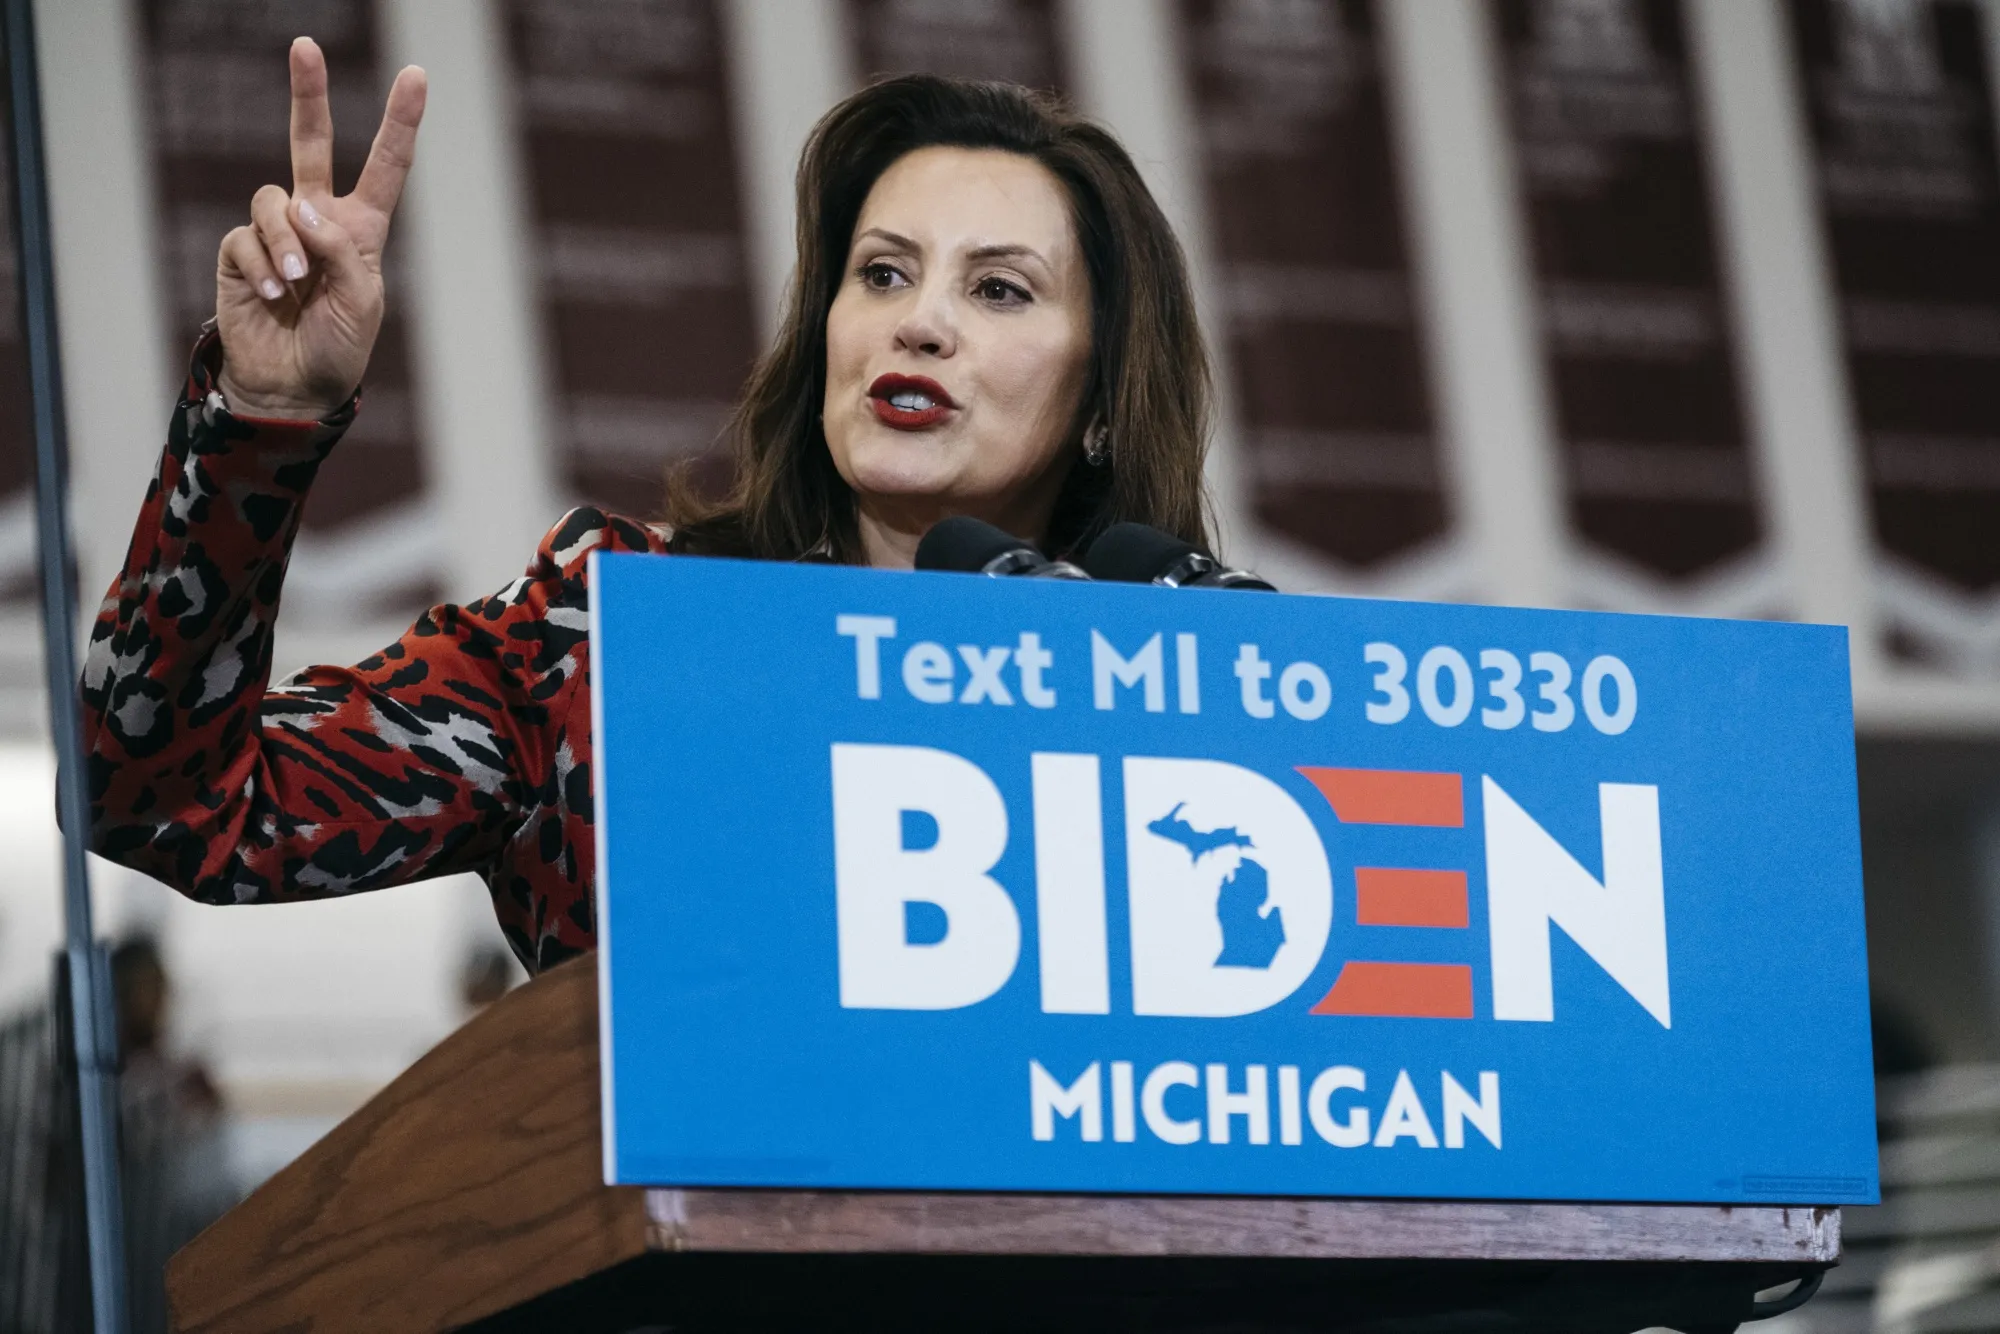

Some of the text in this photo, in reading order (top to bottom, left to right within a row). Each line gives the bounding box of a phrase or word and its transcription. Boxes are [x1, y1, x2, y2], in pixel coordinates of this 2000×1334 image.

[835, 613, 1638, 736] Text MI to 30330
[830, 742, 1672, 1030] BIDEN
[1029, 1060, 1503, 1151] MICHIGAN
